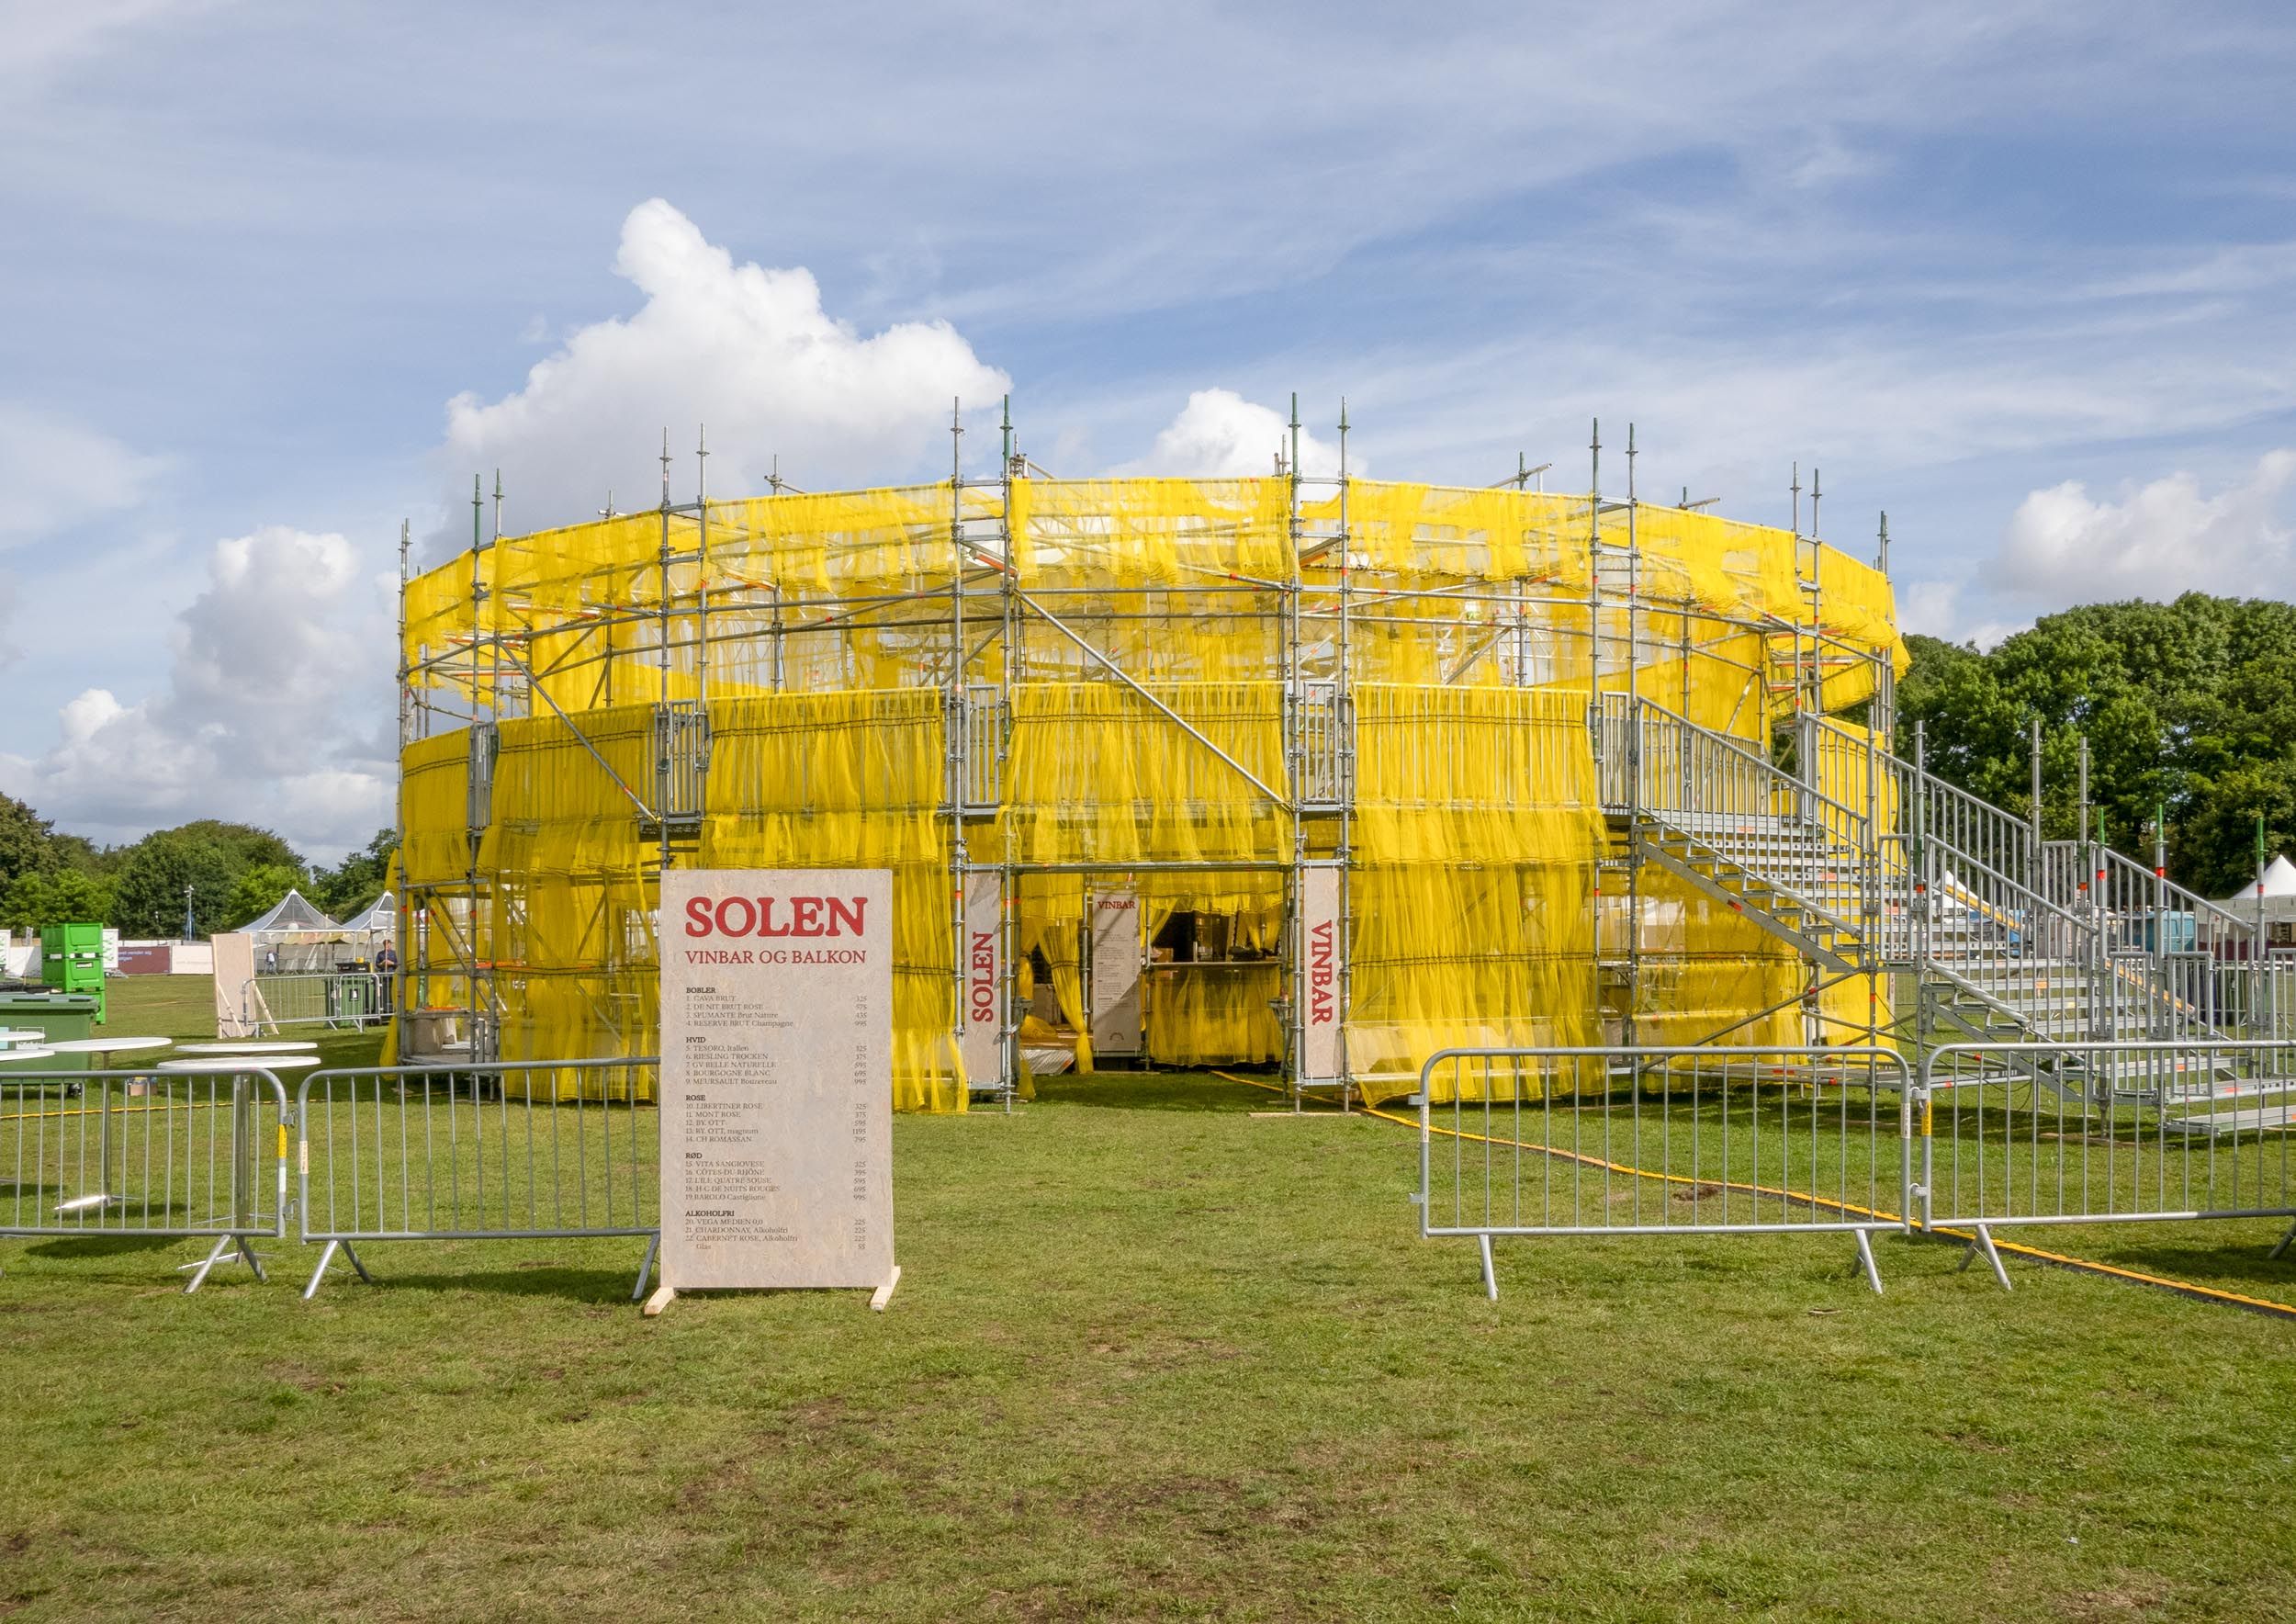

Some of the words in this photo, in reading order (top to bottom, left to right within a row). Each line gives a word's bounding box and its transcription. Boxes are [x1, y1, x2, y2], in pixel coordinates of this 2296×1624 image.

[685, 896, 869, 938] SOLEN
[1097, 900, 1136, 909] VINBAR
[685, 951, 754, 964] VINBAR
[759, 951, 787, 964] OG
[792, 951, 866, 964] BALKON
[972, 931, 994, 1022] SOLEN
[1311, 919, 1334, 1026] VINBAR
